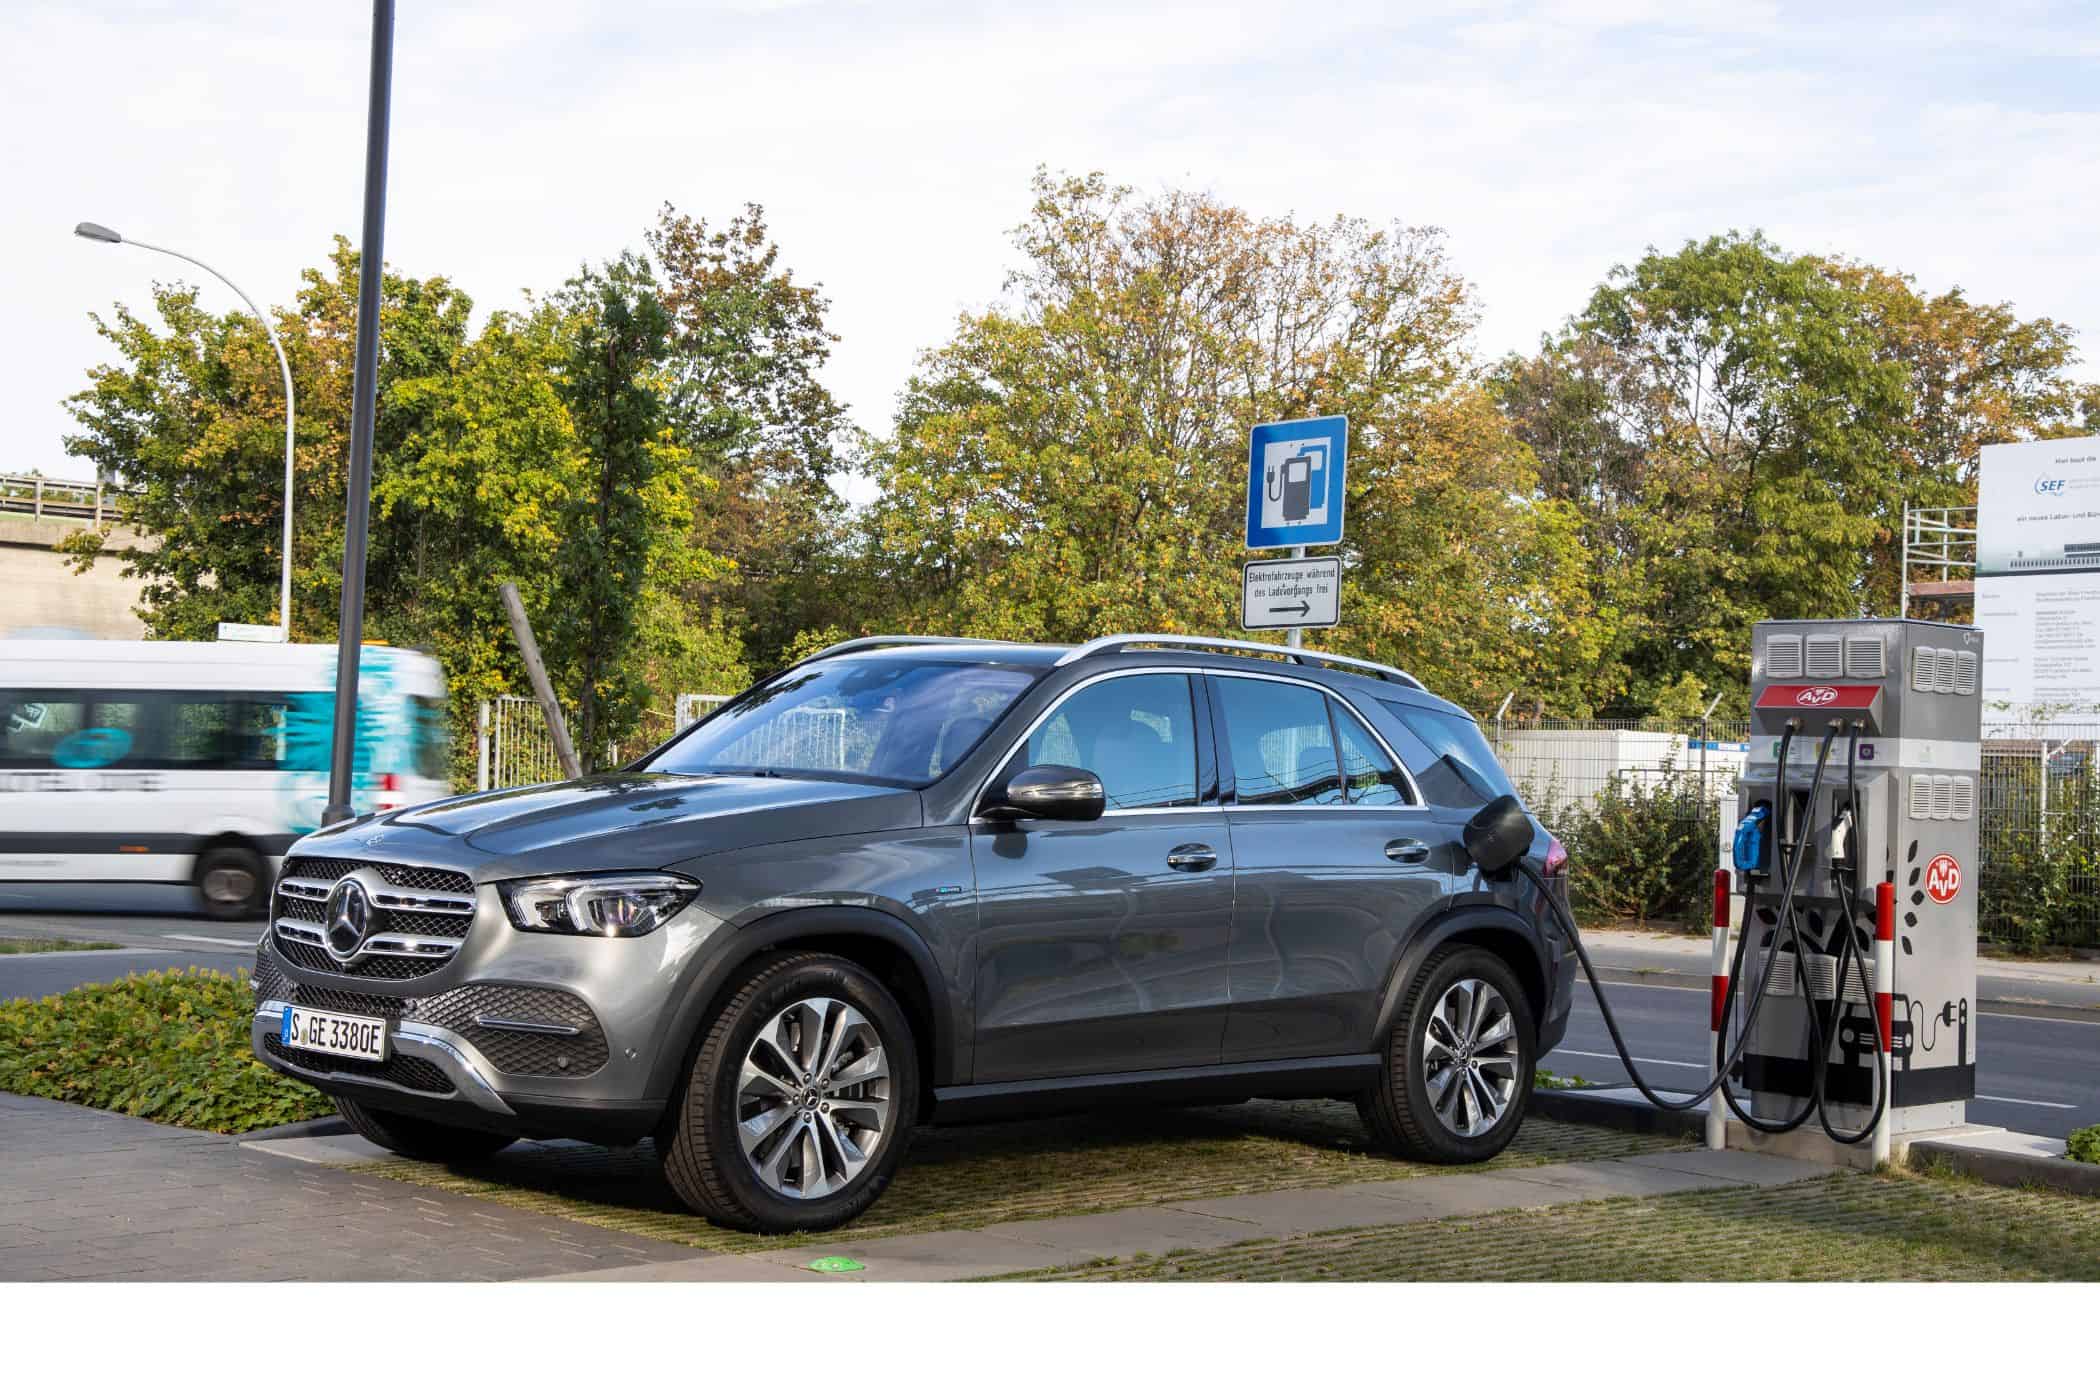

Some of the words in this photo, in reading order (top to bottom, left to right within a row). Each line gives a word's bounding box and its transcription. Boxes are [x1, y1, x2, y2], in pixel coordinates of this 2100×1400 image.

[2039, 479, 2066, 492] SEF
[1249, 570, 1304, 583] Elektrofahrzeuge
[1306, 568, 1335, 579] während
[1254, 587, 1266, 598] des
[1268, 586, 1313, 598] Ladevorgangs
[1316, 583, 1328, 593] frei
[291, 1013, 300, 1041] S
[309, 1016, 327, 1047] GE
[329, 1020, 381, 1054] 3380E
